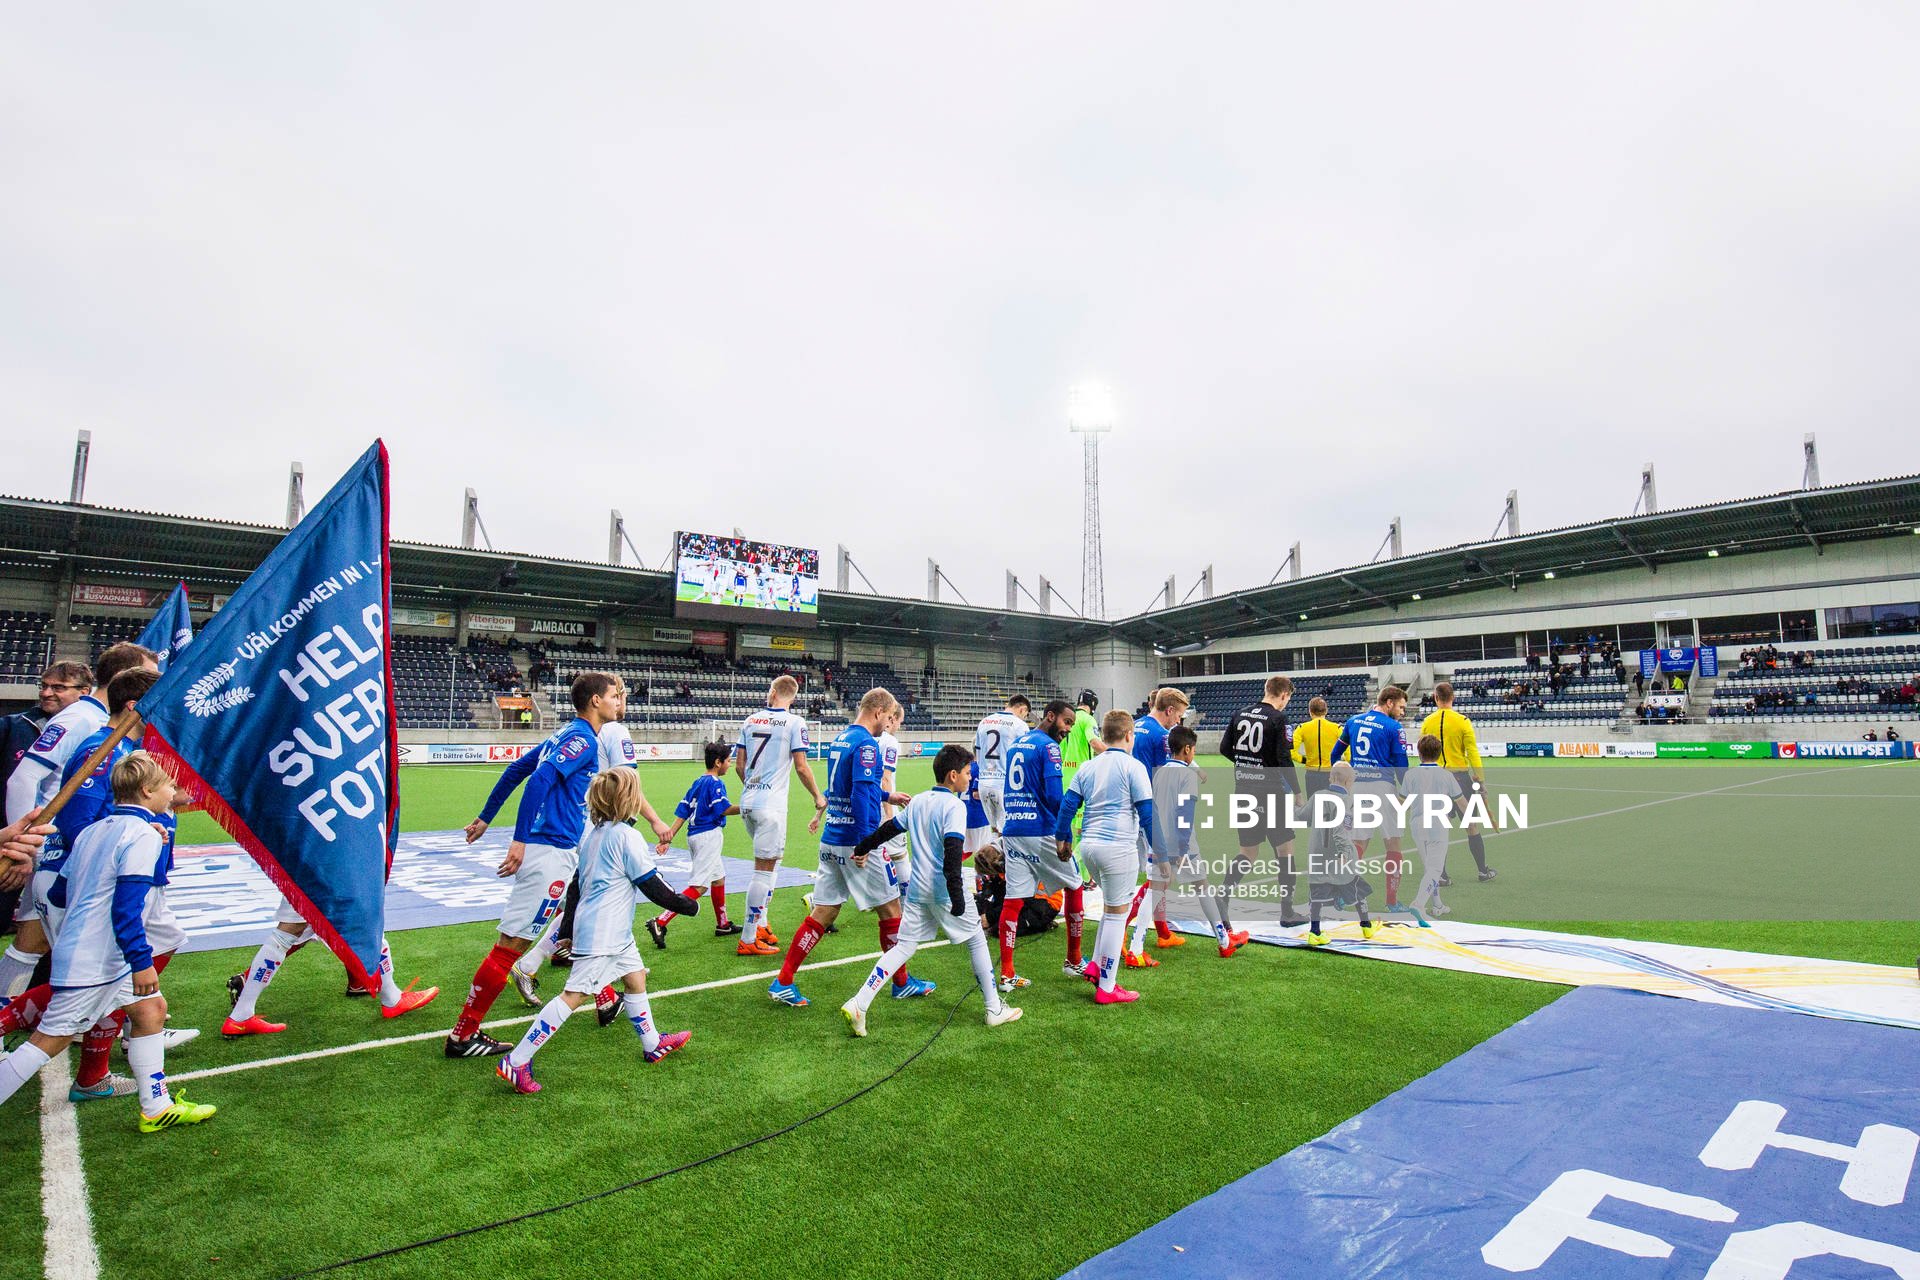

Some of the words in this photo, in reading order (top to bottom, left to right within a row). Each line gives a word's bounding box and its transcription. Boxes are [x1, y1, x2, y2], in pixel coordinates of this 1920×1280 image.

[237, 576, 343, 660] VÄLKOMMEN
[339, 565, 363, 586] IN
[359, 560, 372, 575] I
[531, 619, 577, 635] JAMBACK
[654, 629, 692, 641] Magasinet
[750, 732, 772, 770] 7
[985, 729, 1001, 760] 2
[1235, 719, 1264, 753] 20
[1355, 726, 1373, 755] 5
[1729, 744, 1752, 752] coop
[1799, 743, 1892, 757] STRYKTIPSET
[465, 752, 483, 760] Gävle
[1008, 751, 1025, 791] 6
[828, 751, 841, 793] 7
[298, 742, 385, 842] FOT
[531, 924, 541, 934] 10
